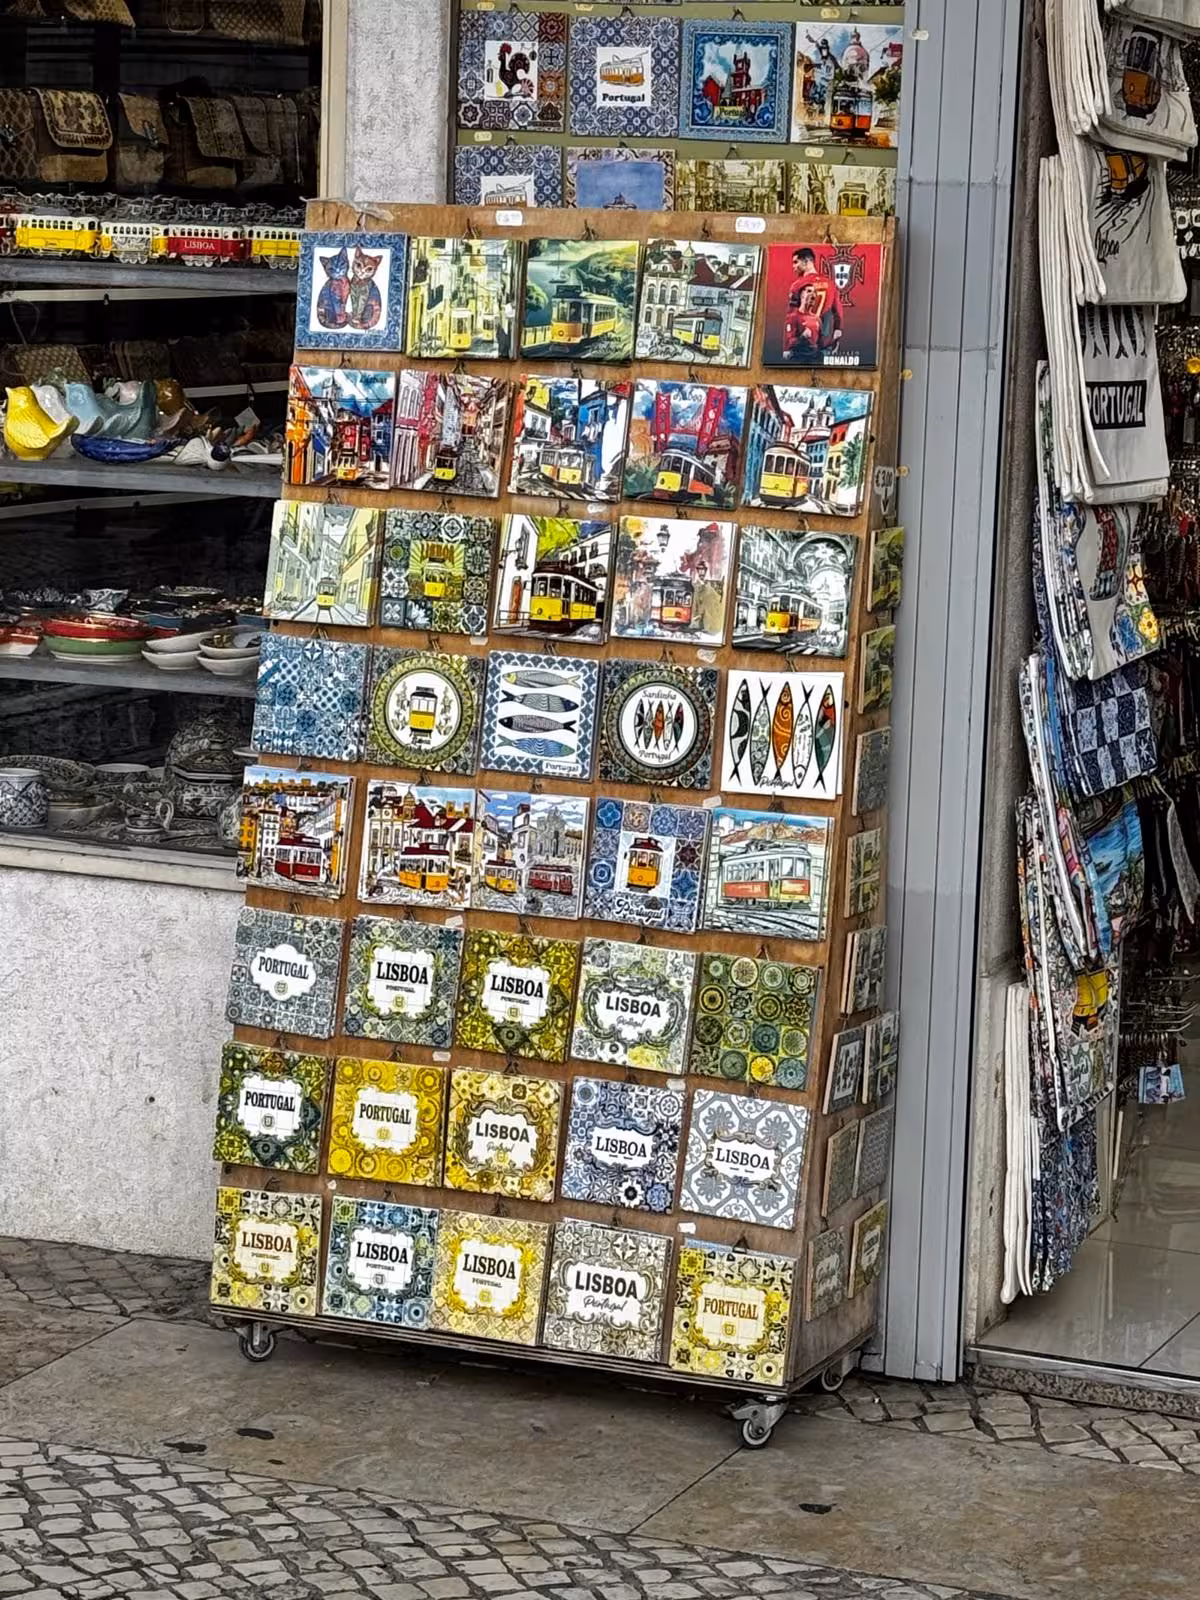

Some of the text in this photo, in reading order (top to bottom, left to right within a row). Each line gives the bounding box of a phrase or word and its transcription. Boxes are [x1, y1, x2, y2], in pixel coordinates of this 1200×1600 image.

[602, 93, 646, 103] Portugal
[184, 240, 216, 251] LISBOA
[823, 355, 860, 366] RONALDO
[778, 389, 808, 404] Lisboa
[1086, 385, 1143, 425] PORTUGAL
[642, 688, 677, 701] Sardinha
[545, 762, 579, 773] Portugal
[638, 749, 675, 763] Portugal
[615, 898, 664, 923] Portugal
[258, 956, 309, 980] PORTUGAL
[376, 961, 428, 985] LISBOA
[490, 974, 544, 998] LISBOA
[605, 995, 661, 1018] LISBOA
[244, 1090, 296, 1112] PORTUGAL
[359, 1103, 412, 1125] PORTUGAL
[475, 1121, 530, 1143] LISBOA
[595, 1135, 647, 1158] LISBOA
[715, 1147, 770, 1171] LISBOA
[241, 1231, 293, 1254] LISBOA
[356, 1241, 409, 1265] LISBOA
[462, 1253, 516, 1280] LISBOA
[575, 1270, 638, 1300] LISBOA
[583, 1295, 629, 1312] Portugal
[703, 1297, 760, 1321] PORTUGAL
